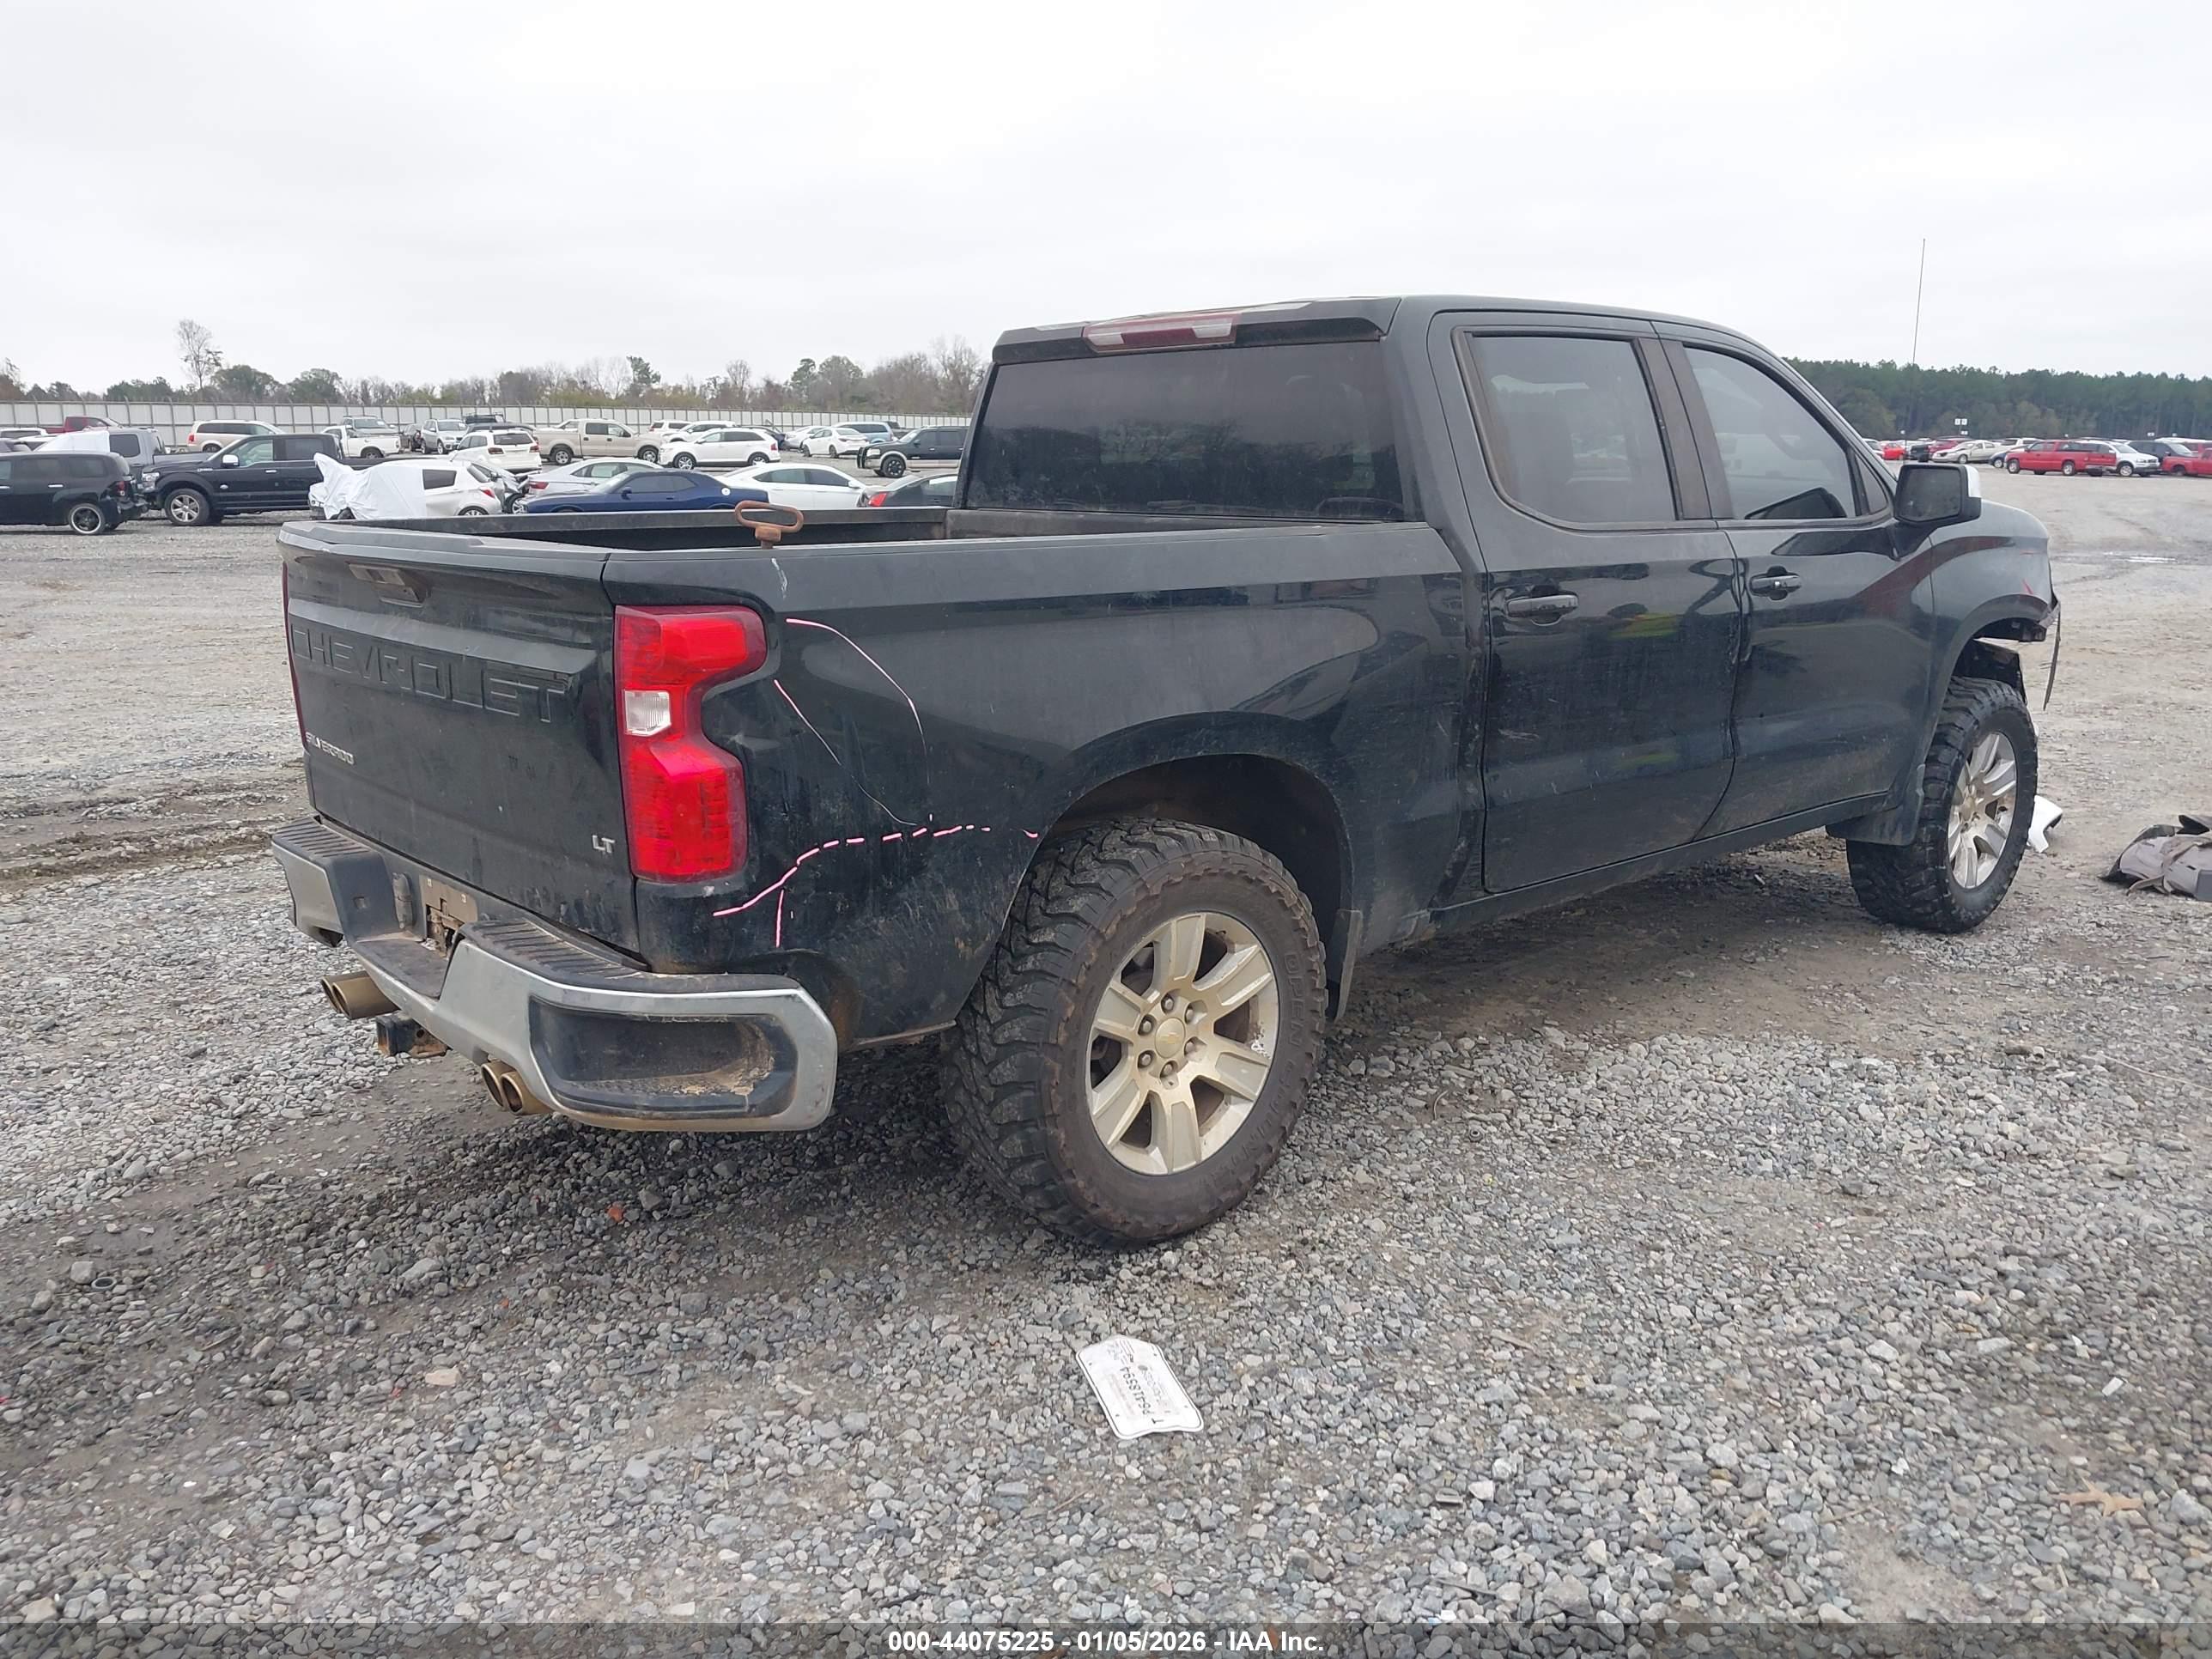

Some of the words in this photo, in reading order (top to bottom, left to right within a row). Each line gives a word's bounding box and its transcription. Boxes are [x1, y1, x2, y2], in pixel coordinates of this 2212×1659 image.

[290, 623, 566, 723] CHEVROLET
[305, 731, 355, 765] SILVERADO
[592, 835, 616, 854] LT
[1285, 952, 1306, 1047] OPEN
